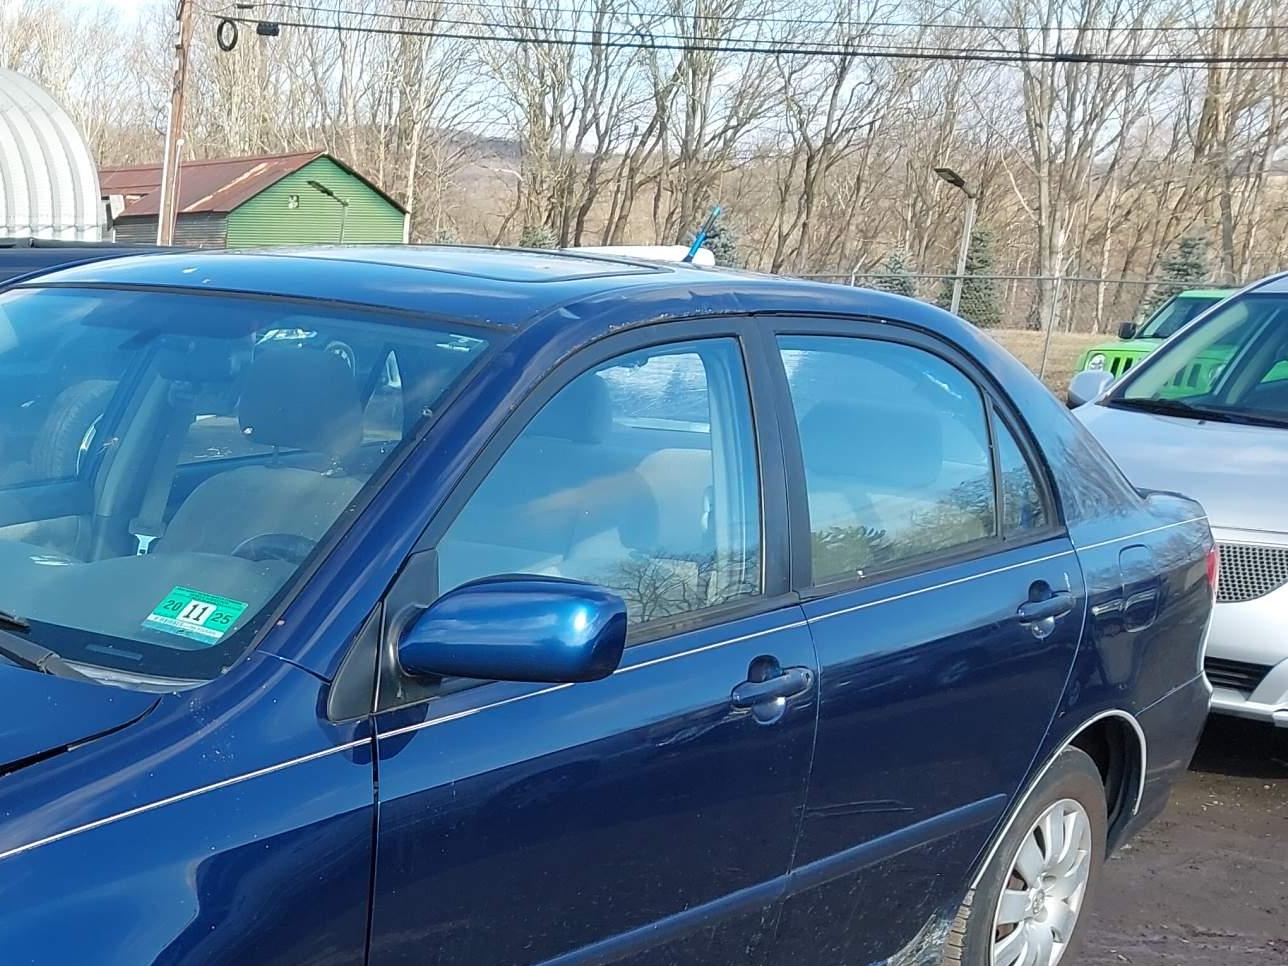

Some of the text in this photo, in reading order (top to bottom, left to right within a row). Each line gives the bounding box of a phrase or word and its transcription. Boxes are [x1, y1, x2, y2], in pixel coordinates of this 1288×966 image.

[163, 599, 183, 611] 20
[183, 603, 209, 621] 11
[211, 612, 232, 625] 25
